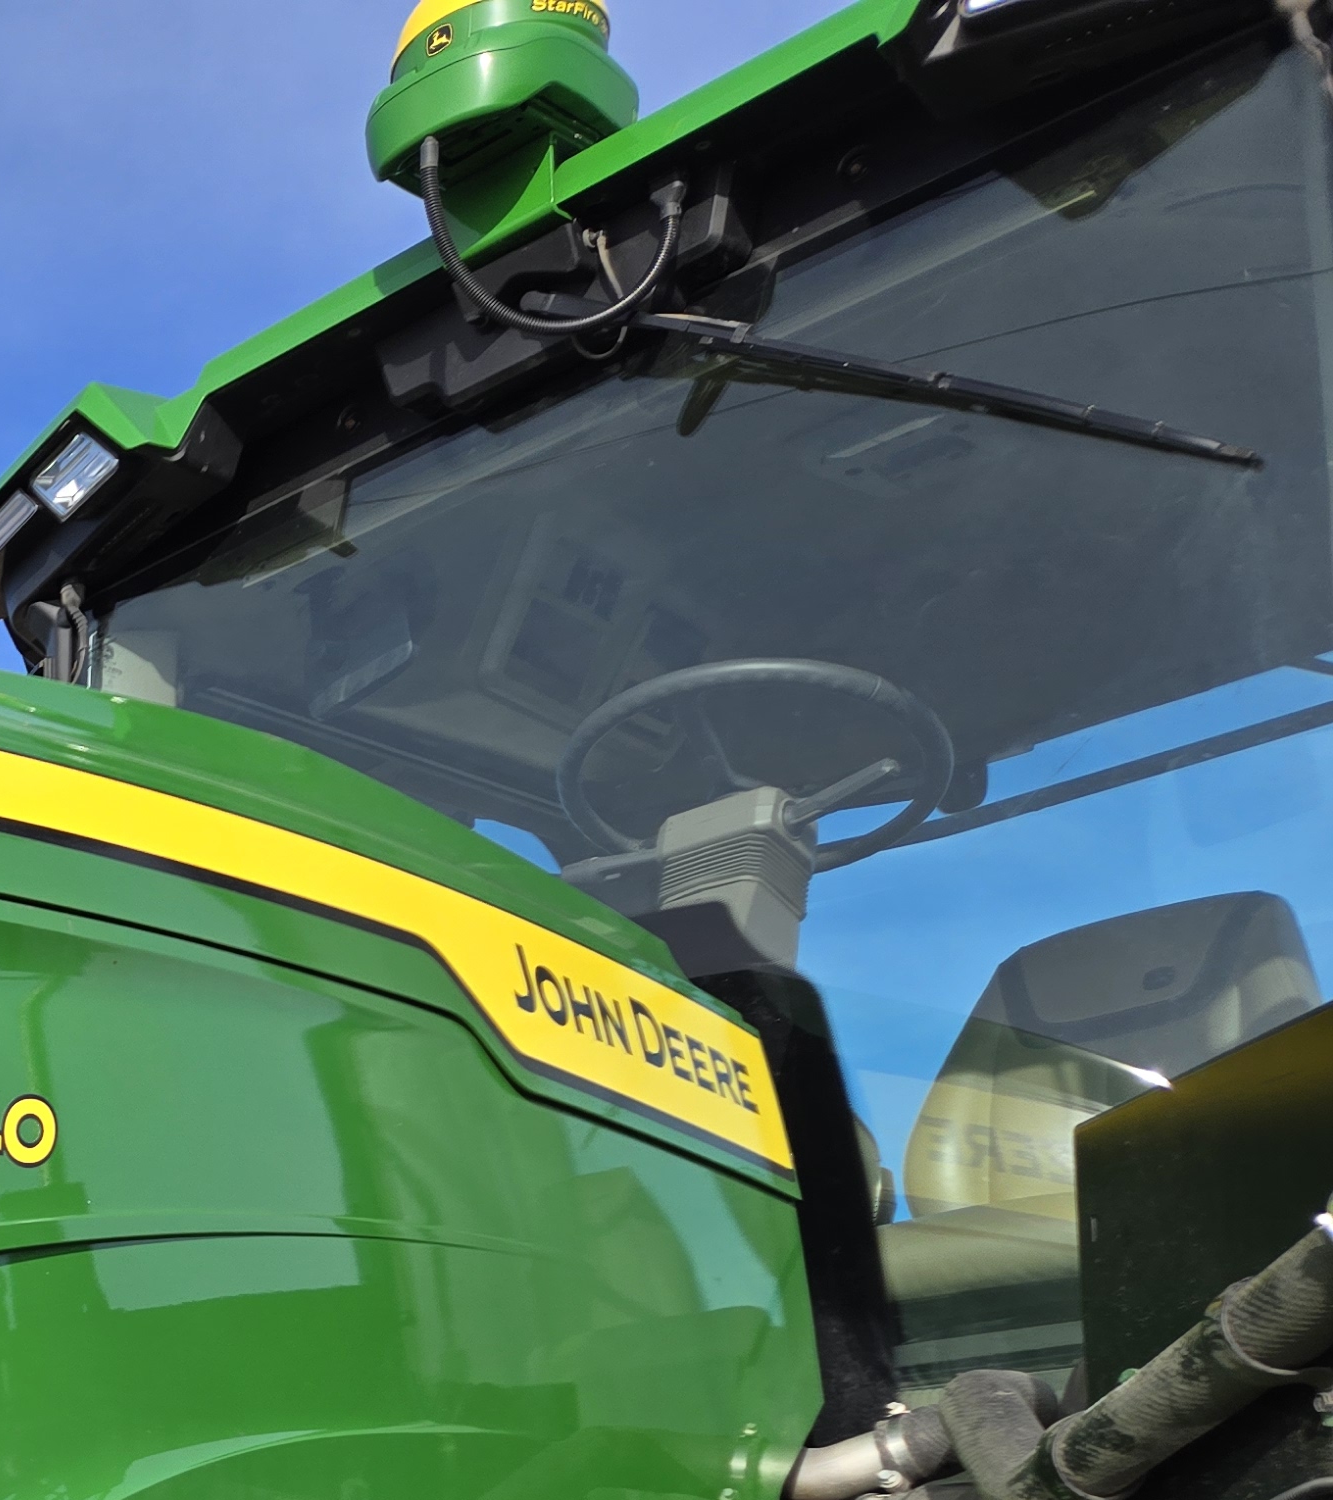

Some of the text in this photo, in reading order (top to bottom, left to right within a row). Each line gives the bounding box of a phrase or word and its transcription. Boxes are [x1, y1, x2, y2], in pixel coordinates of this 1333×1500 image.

[531, 0, 599, 25] StarFire
[511, 943, 760, 1115] JOHN DEERE
